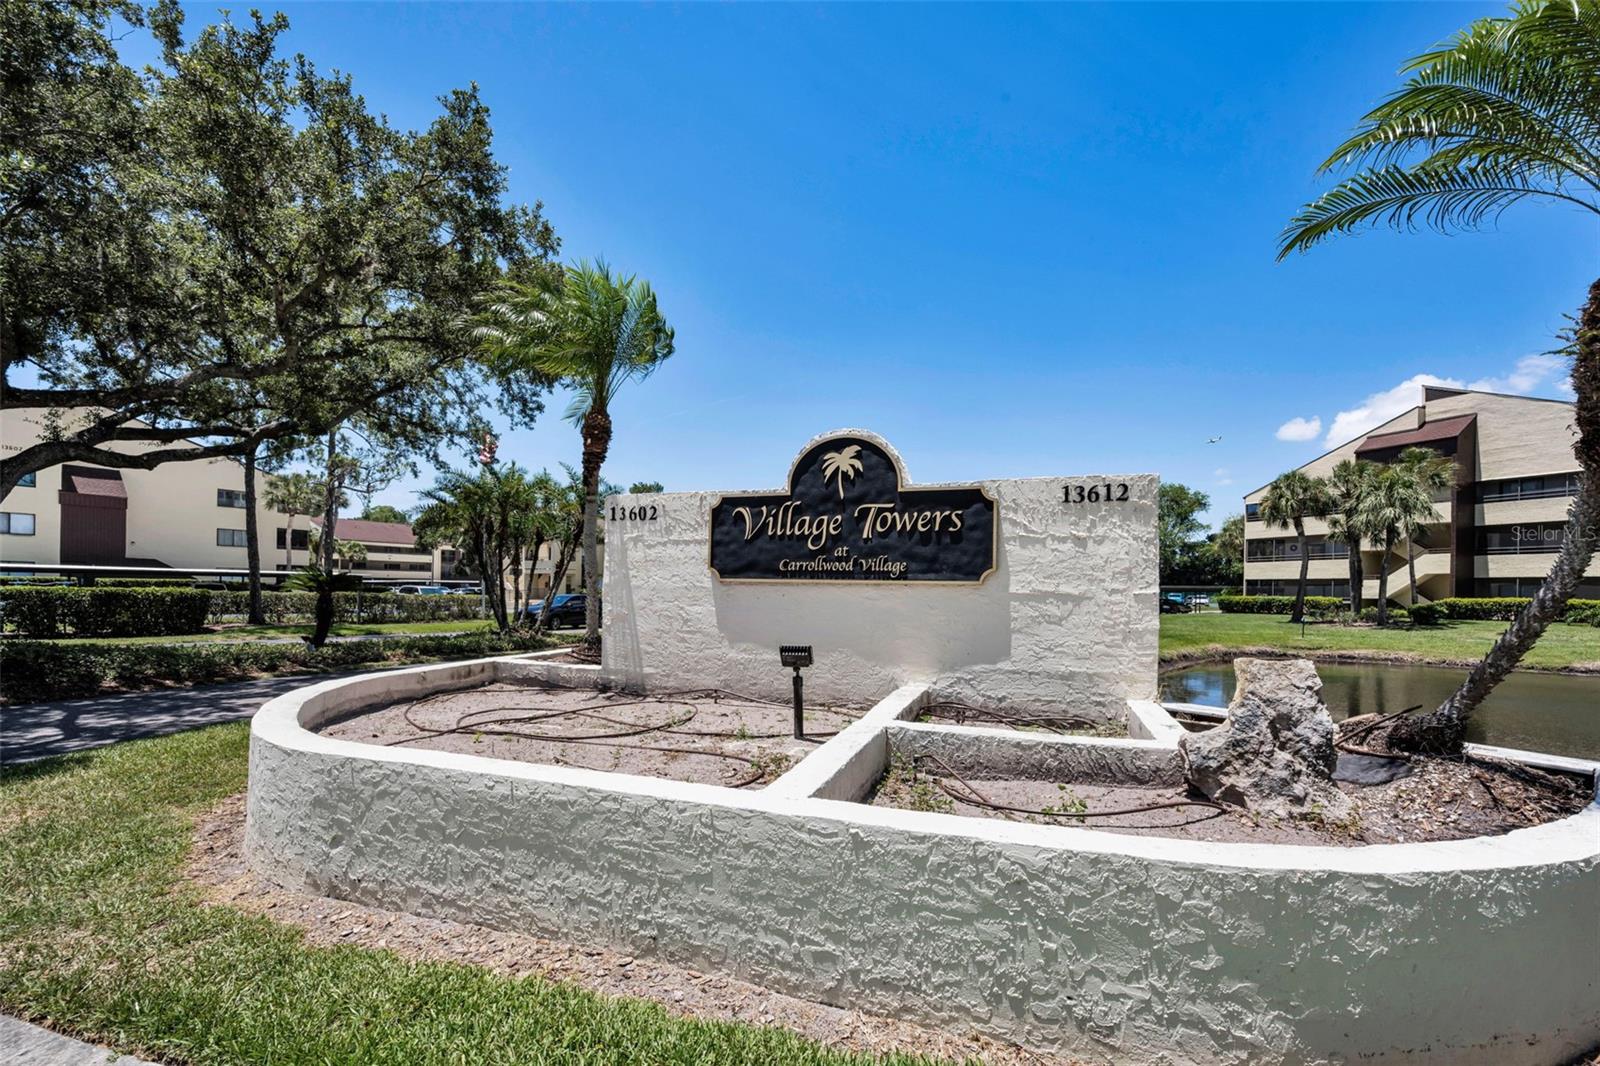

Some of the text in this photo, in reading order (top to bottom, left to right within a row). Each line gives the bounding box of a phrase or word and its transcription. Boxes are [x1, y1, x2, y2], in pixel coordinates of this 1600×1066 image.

[1061, 483, 1129, 503] 13612
[610, 505, 658, 521] 13602
[732, 500, 963, 551] Village Towers
[834, 546, 849, 557] at
[779, 555, 908, 578] Carrollwood Village
